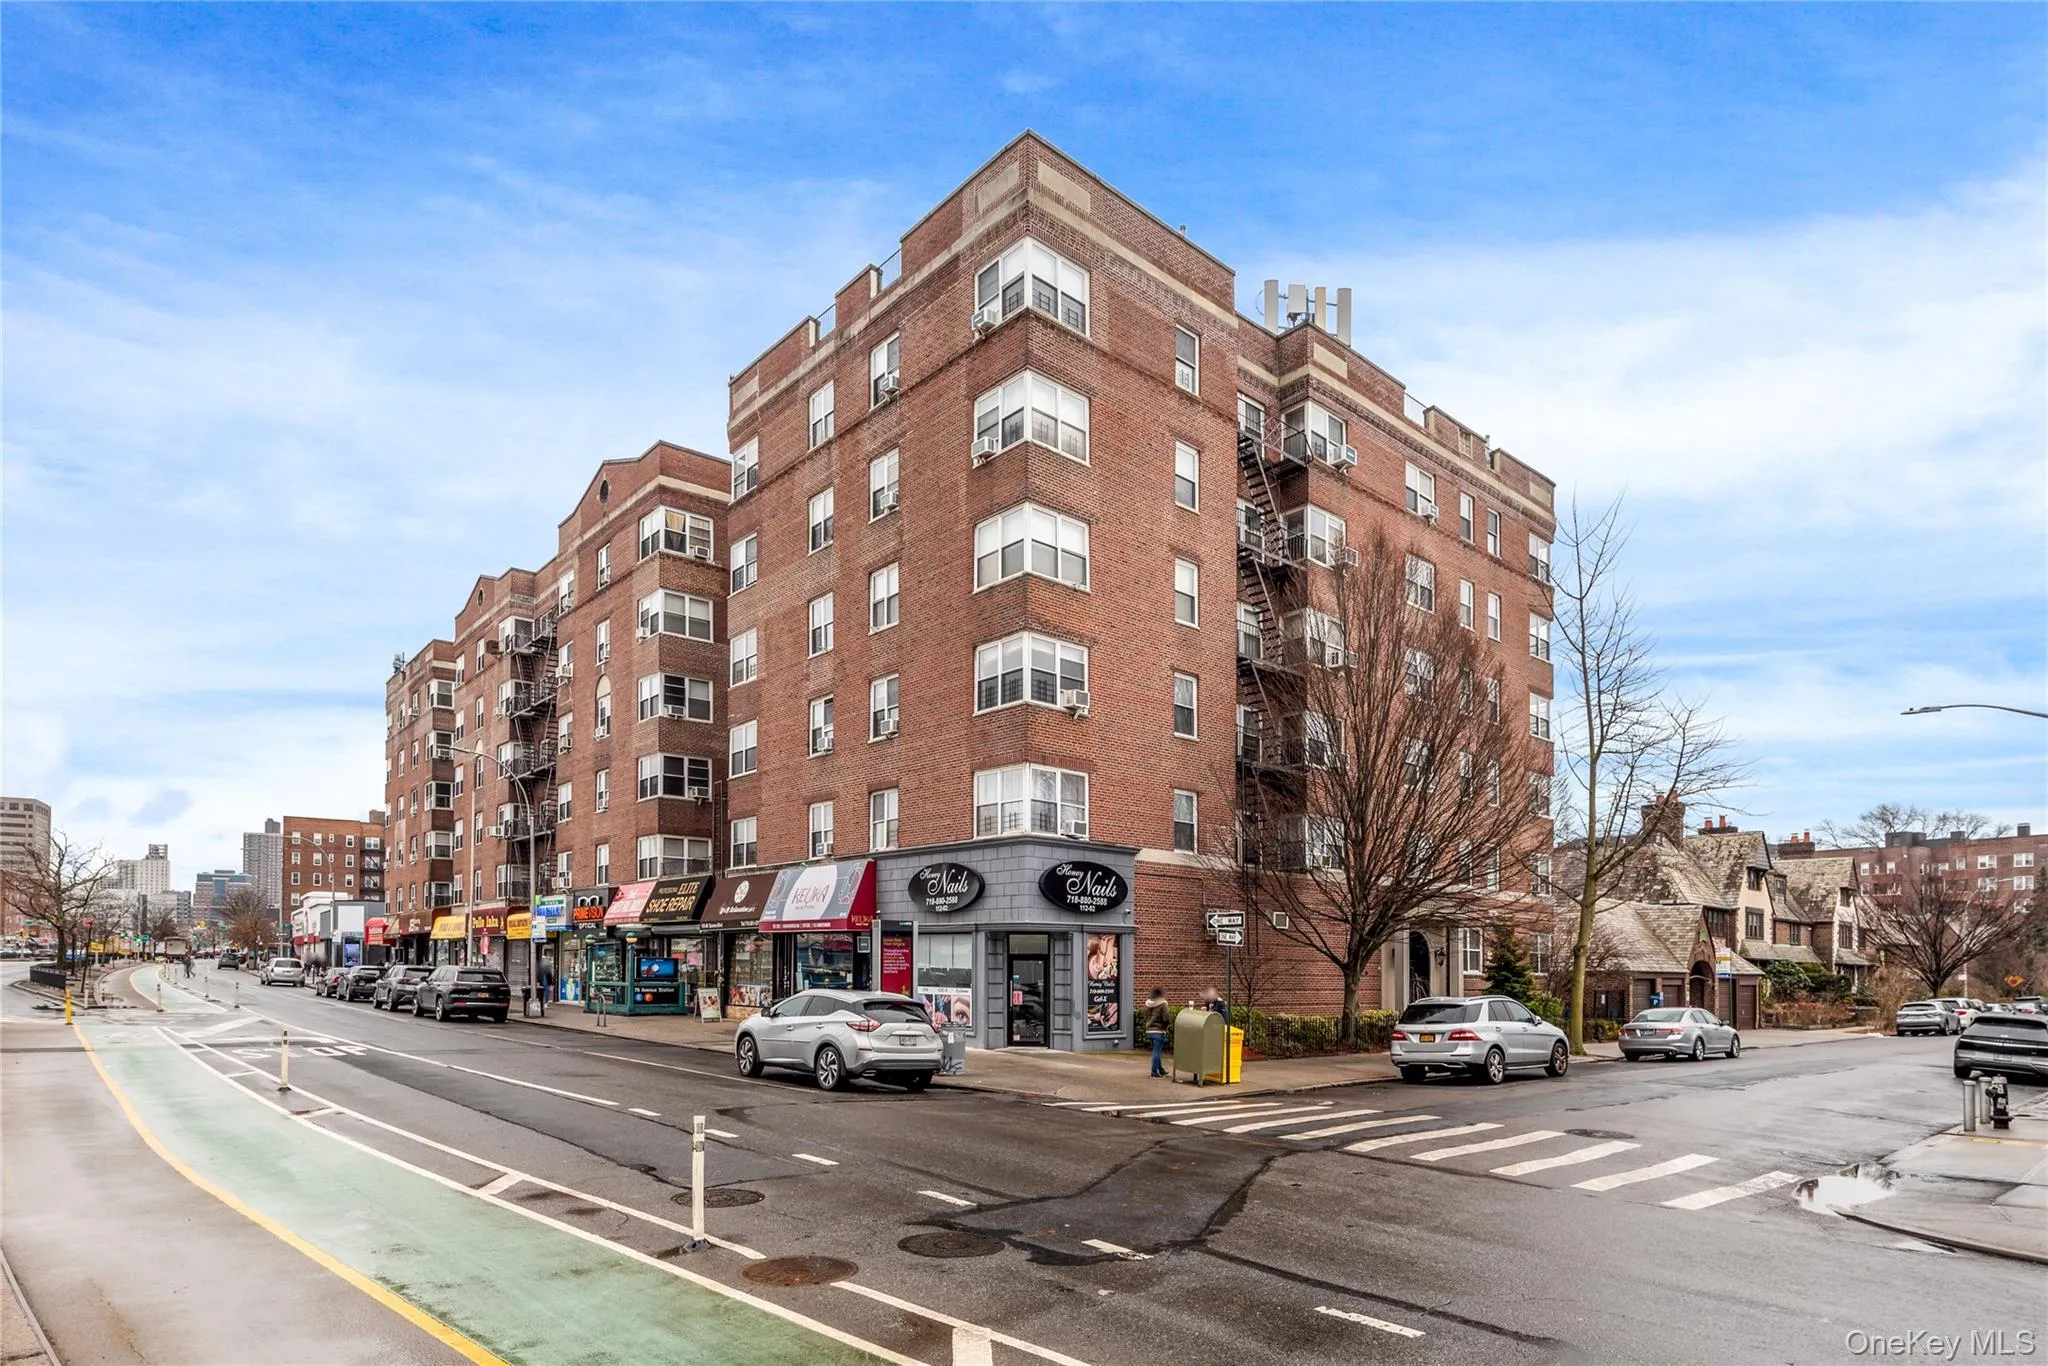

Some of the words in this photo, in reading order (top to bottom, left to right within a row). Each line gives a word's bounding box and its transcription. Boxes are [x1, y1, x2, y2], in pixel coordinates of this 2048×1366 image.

[920, 867, 941, 881] Honey
[1056, 864, 1084, 881] Honey
[677, 881, 701, 895] ELITE
[927, 869, 969, 896] Nails
[1066, 870, 1118, 898] Nails
[646, 898, 670, 913] SHOE
[665, 896, 696, 912] REPAIR
